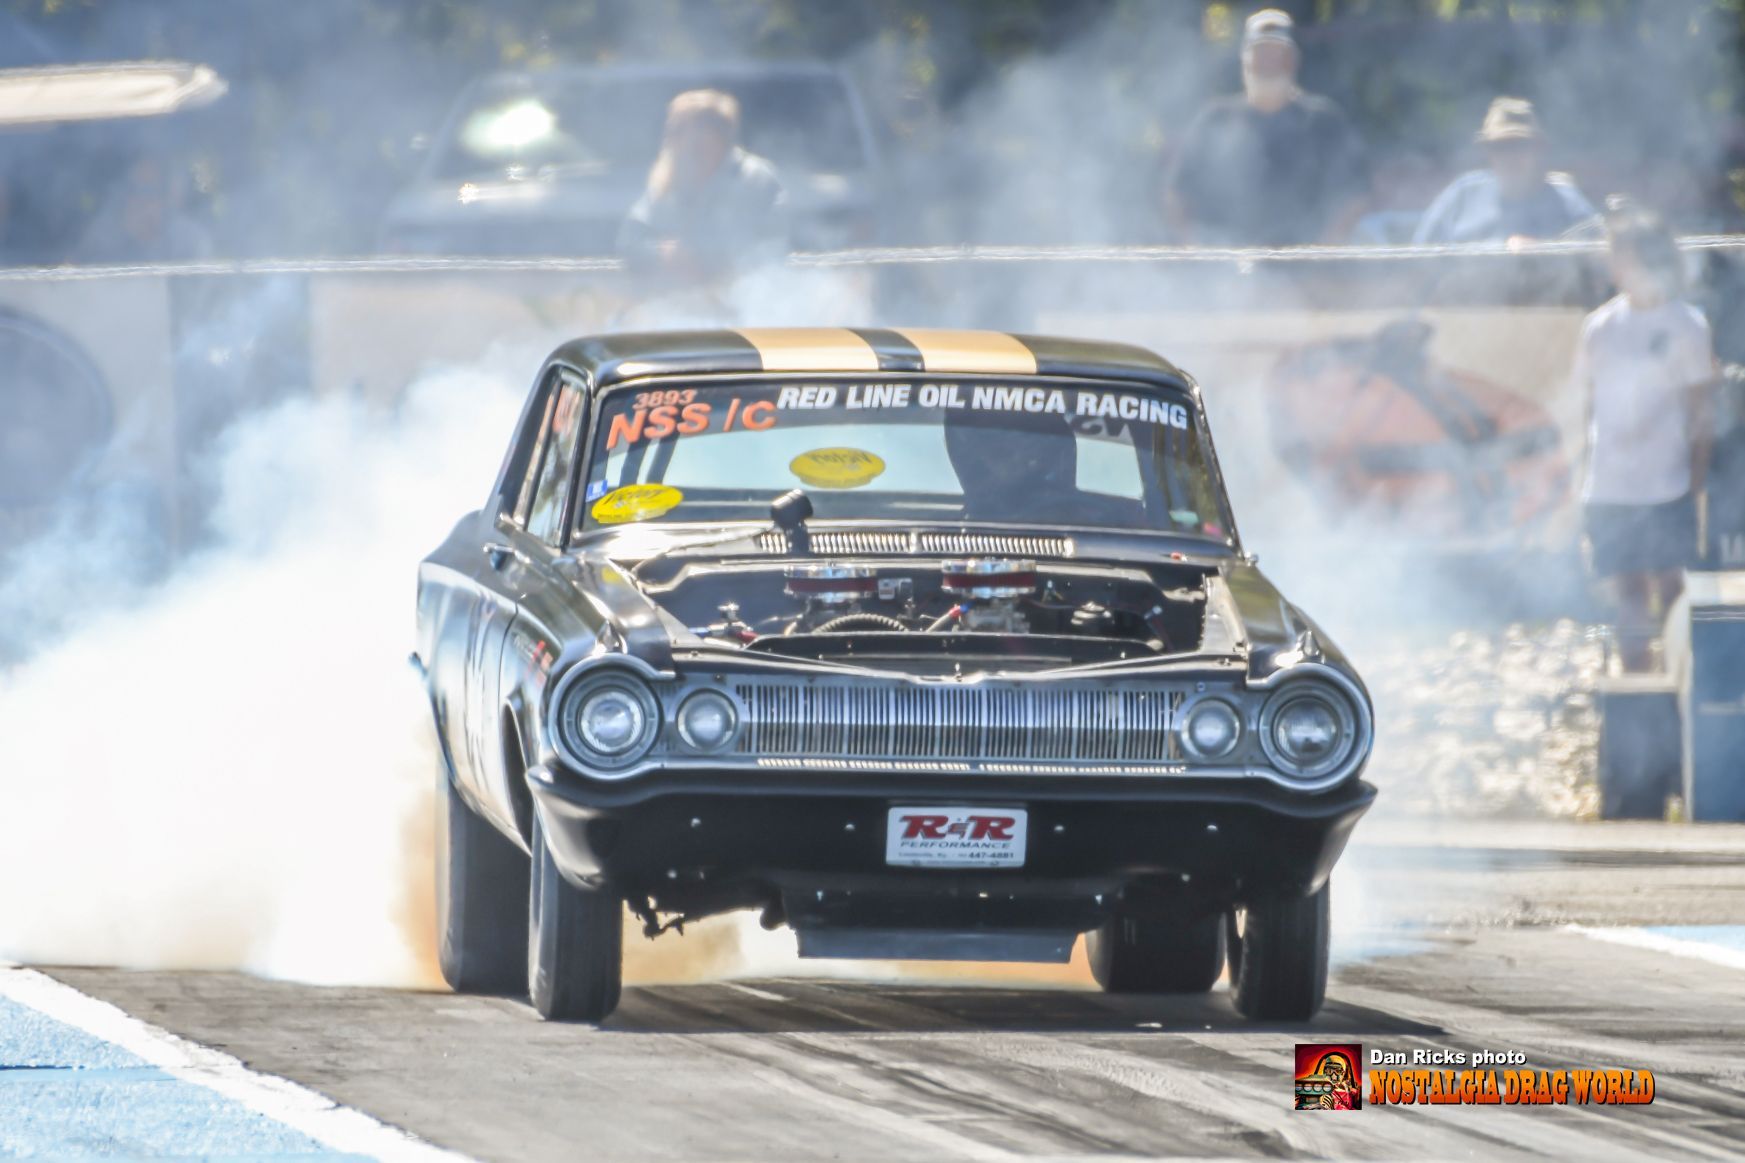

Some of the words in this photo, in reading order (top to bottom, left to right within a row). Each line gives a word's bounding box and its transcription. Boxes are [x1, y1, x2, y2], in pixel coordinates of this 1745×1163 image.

[606, 402, 712, 450] NSS
[777, 387, 836, 411] RED
[846, 384, 911, 411] LINE
[918, 384, 965, 409] OIL
[972, 386, 1066, 414] NMCA
[1075, 392, 1187, 430] RACING
[900, 841, 1011, 849] PERFORMANCE
